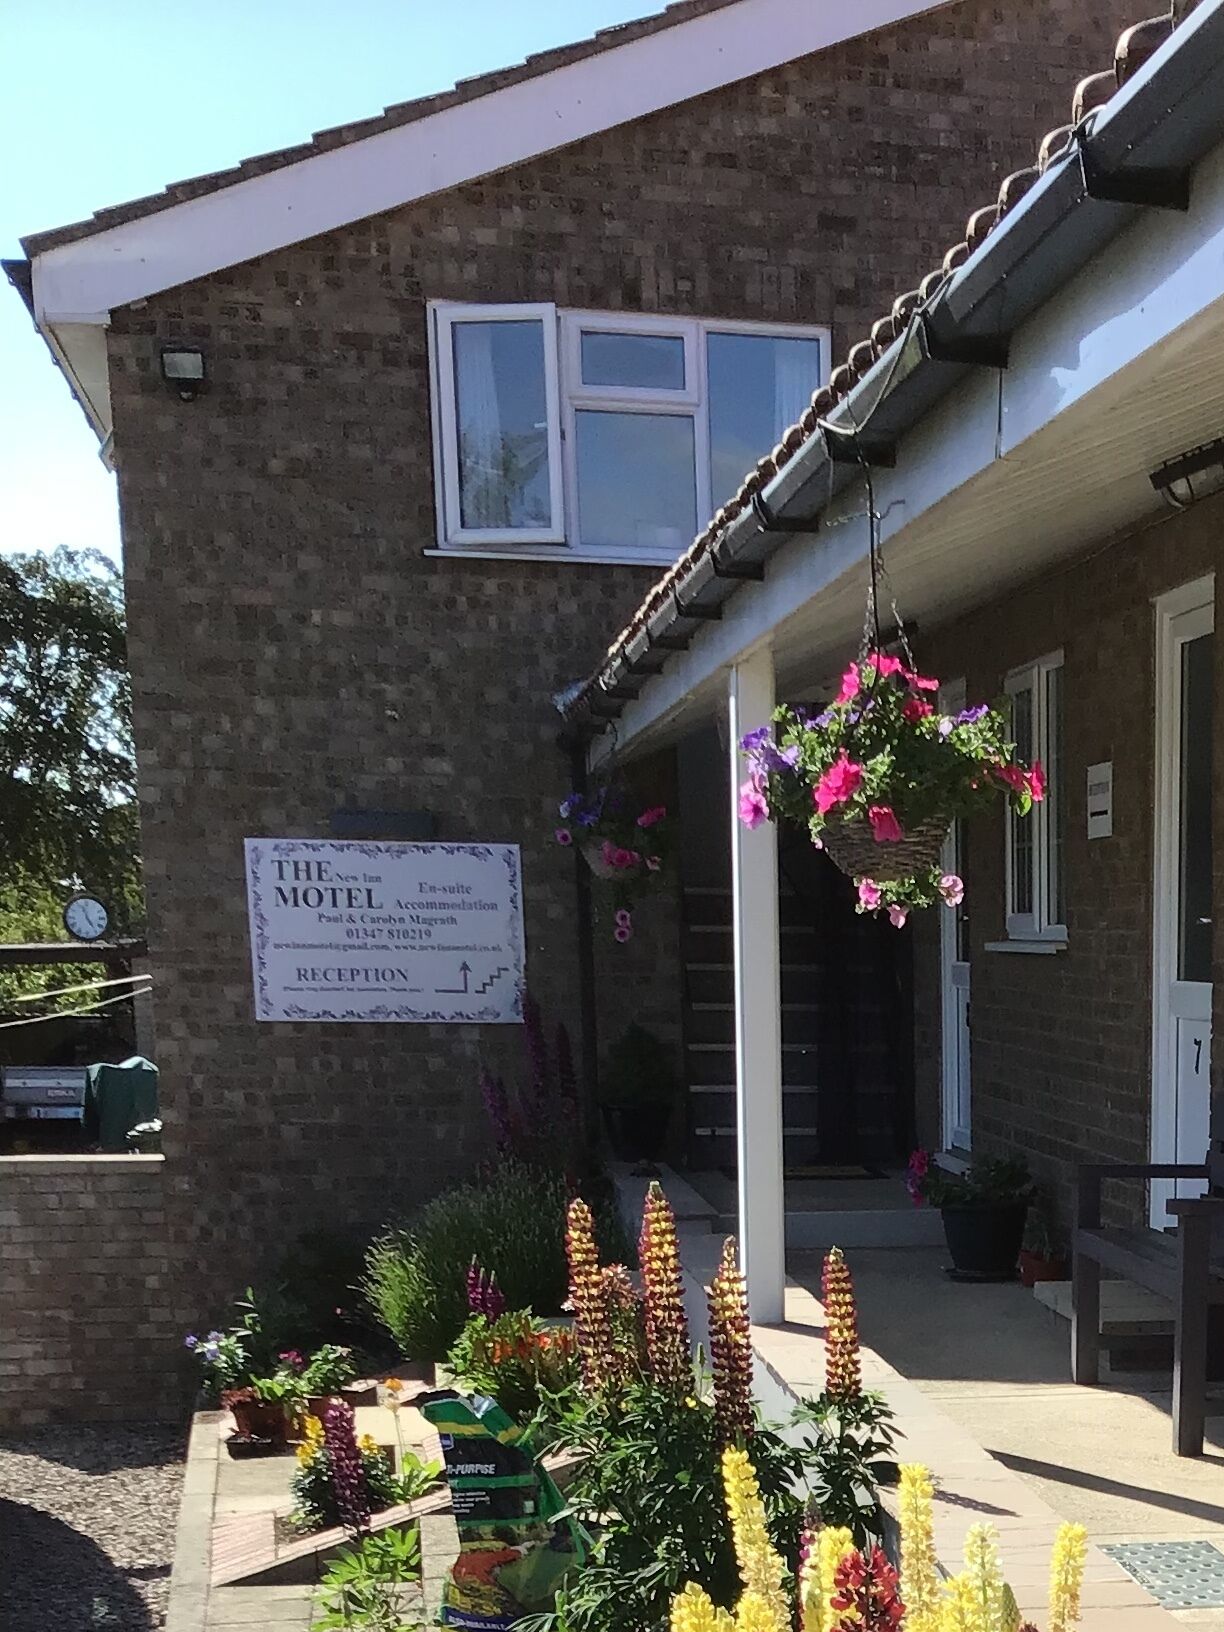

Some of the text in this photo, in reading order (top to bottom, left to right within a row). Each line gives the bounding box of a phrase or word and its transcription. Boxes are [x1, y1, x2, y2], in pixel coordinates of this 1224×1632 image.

[270, 859, 334, 882] THE
[363, 872, 382, 883] Inn
[418, 882, 473, 895] En-suite
[274, 886, 384, 909] MOTEL
[396, 899, 498, 911] Accommodation
[318, 912, 343, 924] Paul
[346, 913, 357, 924] &
[360, 913, 405, 926] Carolyn
[346, 928, 383, 940] 01347
[296, 967, 409, 982] RECEPTION
